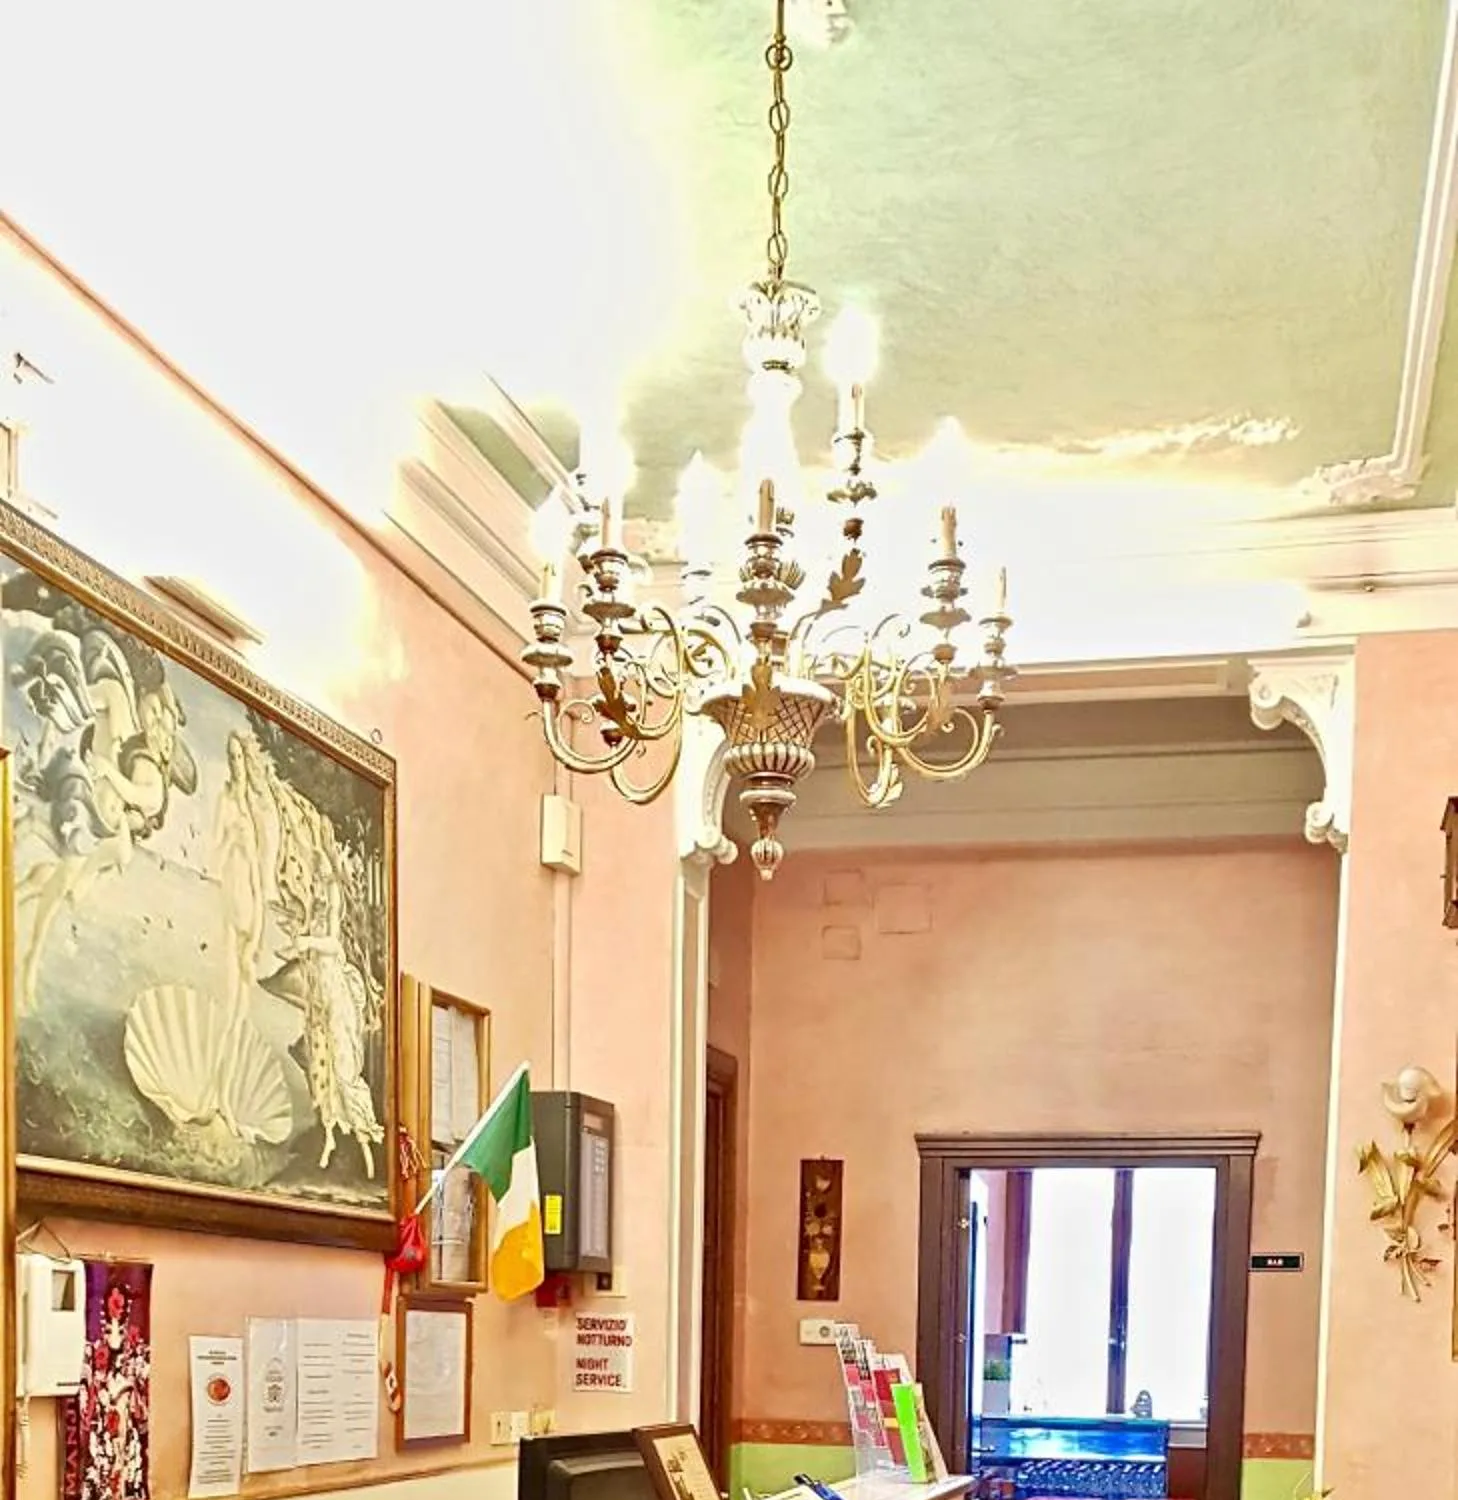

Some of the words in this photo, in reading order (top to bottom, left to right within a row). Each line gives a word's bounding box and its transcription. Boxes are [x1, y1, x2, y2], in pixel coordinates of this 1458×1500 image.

[576, 1317, 628, 1331] SERVIZIO
[576, 1333, 633, 1347] NOTTURNO
[576, 1358, 609, 1371] NIGHT
